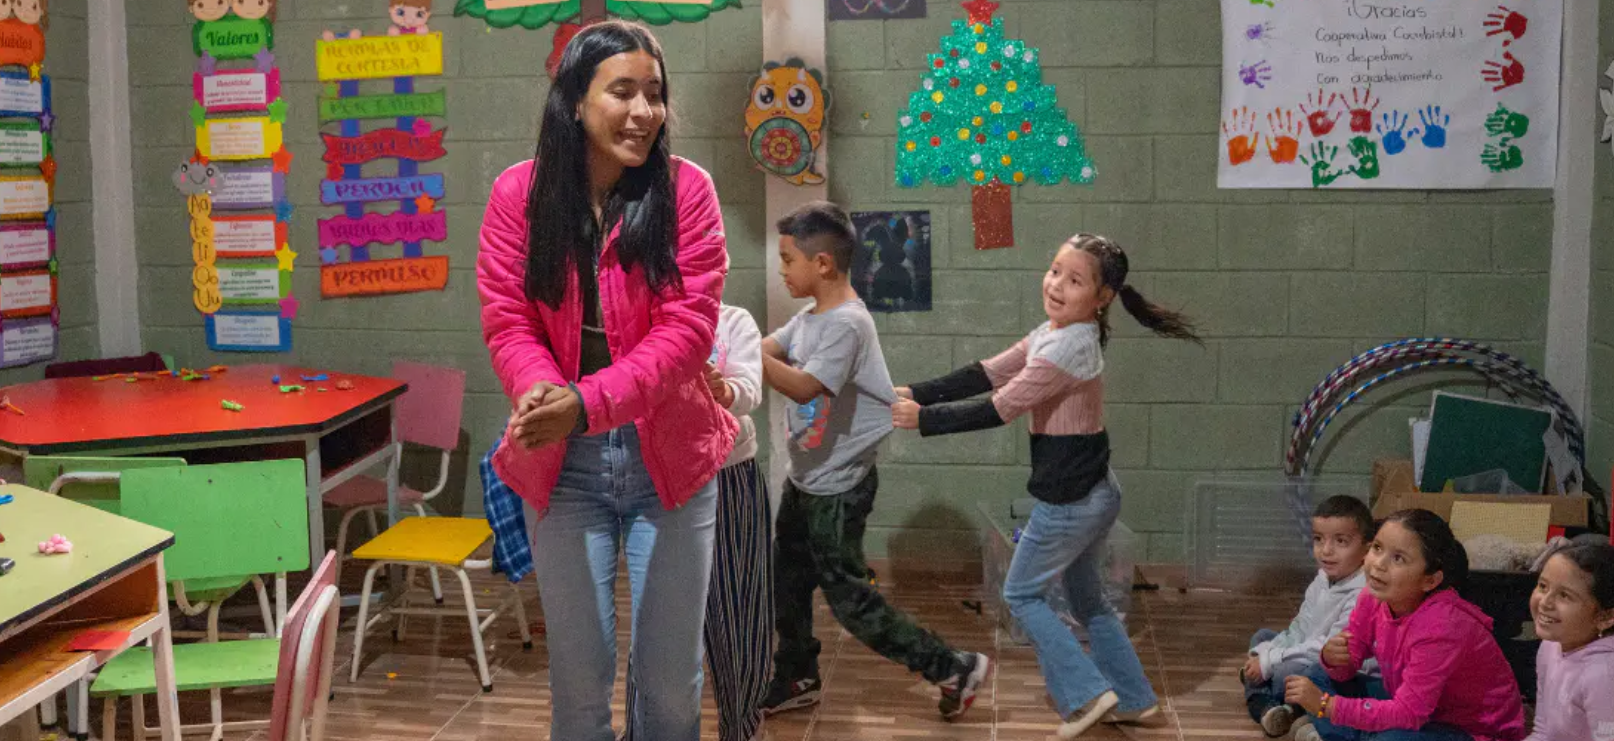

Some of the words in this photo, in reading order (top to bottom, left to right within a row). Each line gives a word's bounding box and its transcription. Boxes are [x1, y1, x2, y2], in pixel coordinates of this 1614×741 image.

[205, 31, 259, 47] Valores
[1315, 26, 1387, 46] Cooperativa
[1346, 46, 1413, 71] despedimos
[1350, 68, 1444, 88] agradecimiento
[333, 266, 437, 287] PERMISO
